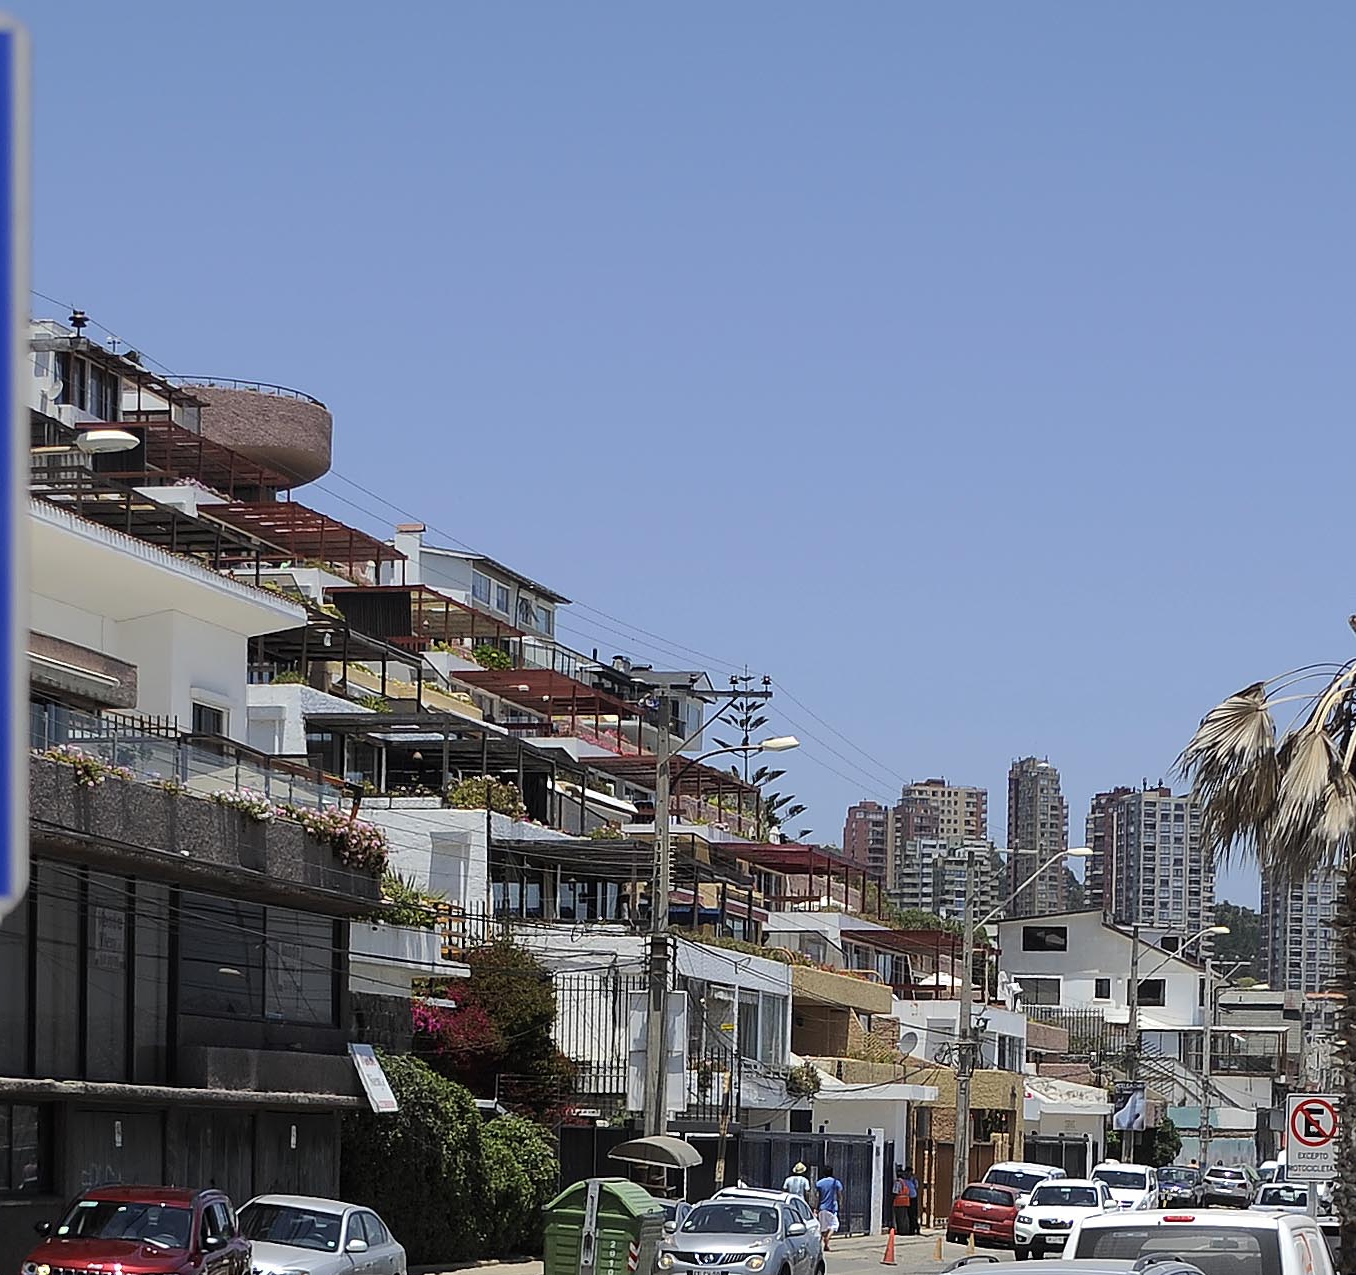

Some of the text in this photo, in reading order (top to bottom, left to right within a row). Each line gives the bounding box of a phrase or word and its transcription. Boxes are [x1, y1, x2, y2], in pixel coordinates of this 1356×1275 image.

[1298, 1152, 1329, 1160] EXCEPTO
[1288, 1164, 1335, 1172] OTOCICLETA
[607, 1241, 617, 1275] 2010
